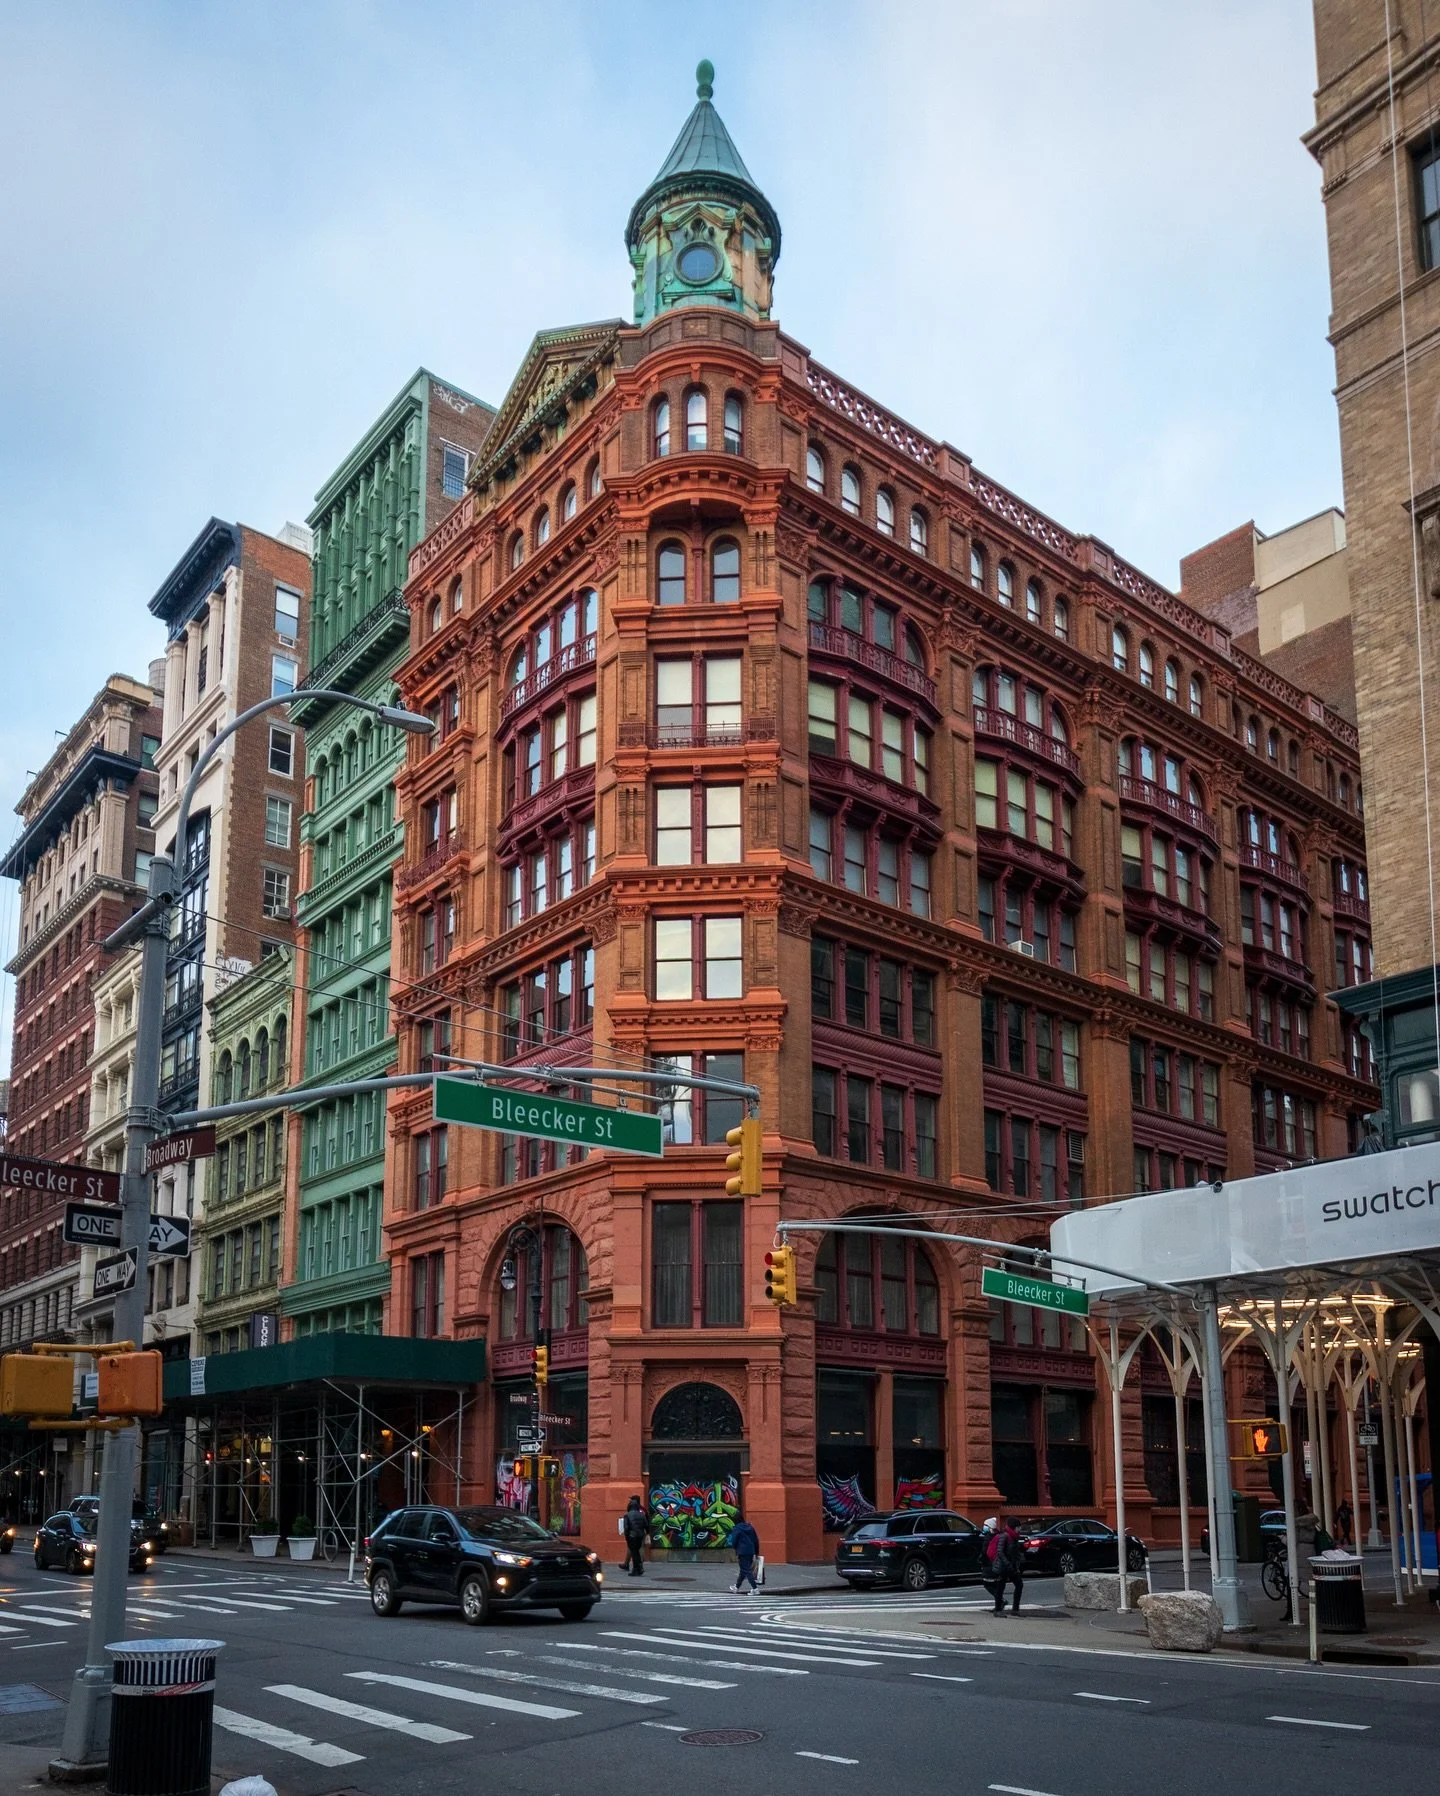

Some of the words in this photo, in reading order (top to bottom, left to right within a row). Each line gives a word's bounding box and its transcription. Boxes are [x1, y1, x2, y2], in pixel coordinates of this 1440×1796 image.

[492, 1097, 586, 1134] Bleecker
[595, 1116, 613, 1139] St
[147, 1138, 193, 1168] Broadway
[2, 1161, 77, 1193] leecker
[86, 1177, 104, 1198] St
[1322, 1179, 1440, 1222] swatch
[77, 1216, 115, 1236] ONE
[149, 1226, 174, 1242] AY
[97, 1268, 111, 1285] ONE
[117, 1261, 131, 1281] WAY
[1008, 1280, 1052, 1302] Bleecker
[1055, 1291, 1065, 1305] St
[260, 1316, 269, 1347] CLOCK
[540, 1414, 564, 1424] Bleecker
